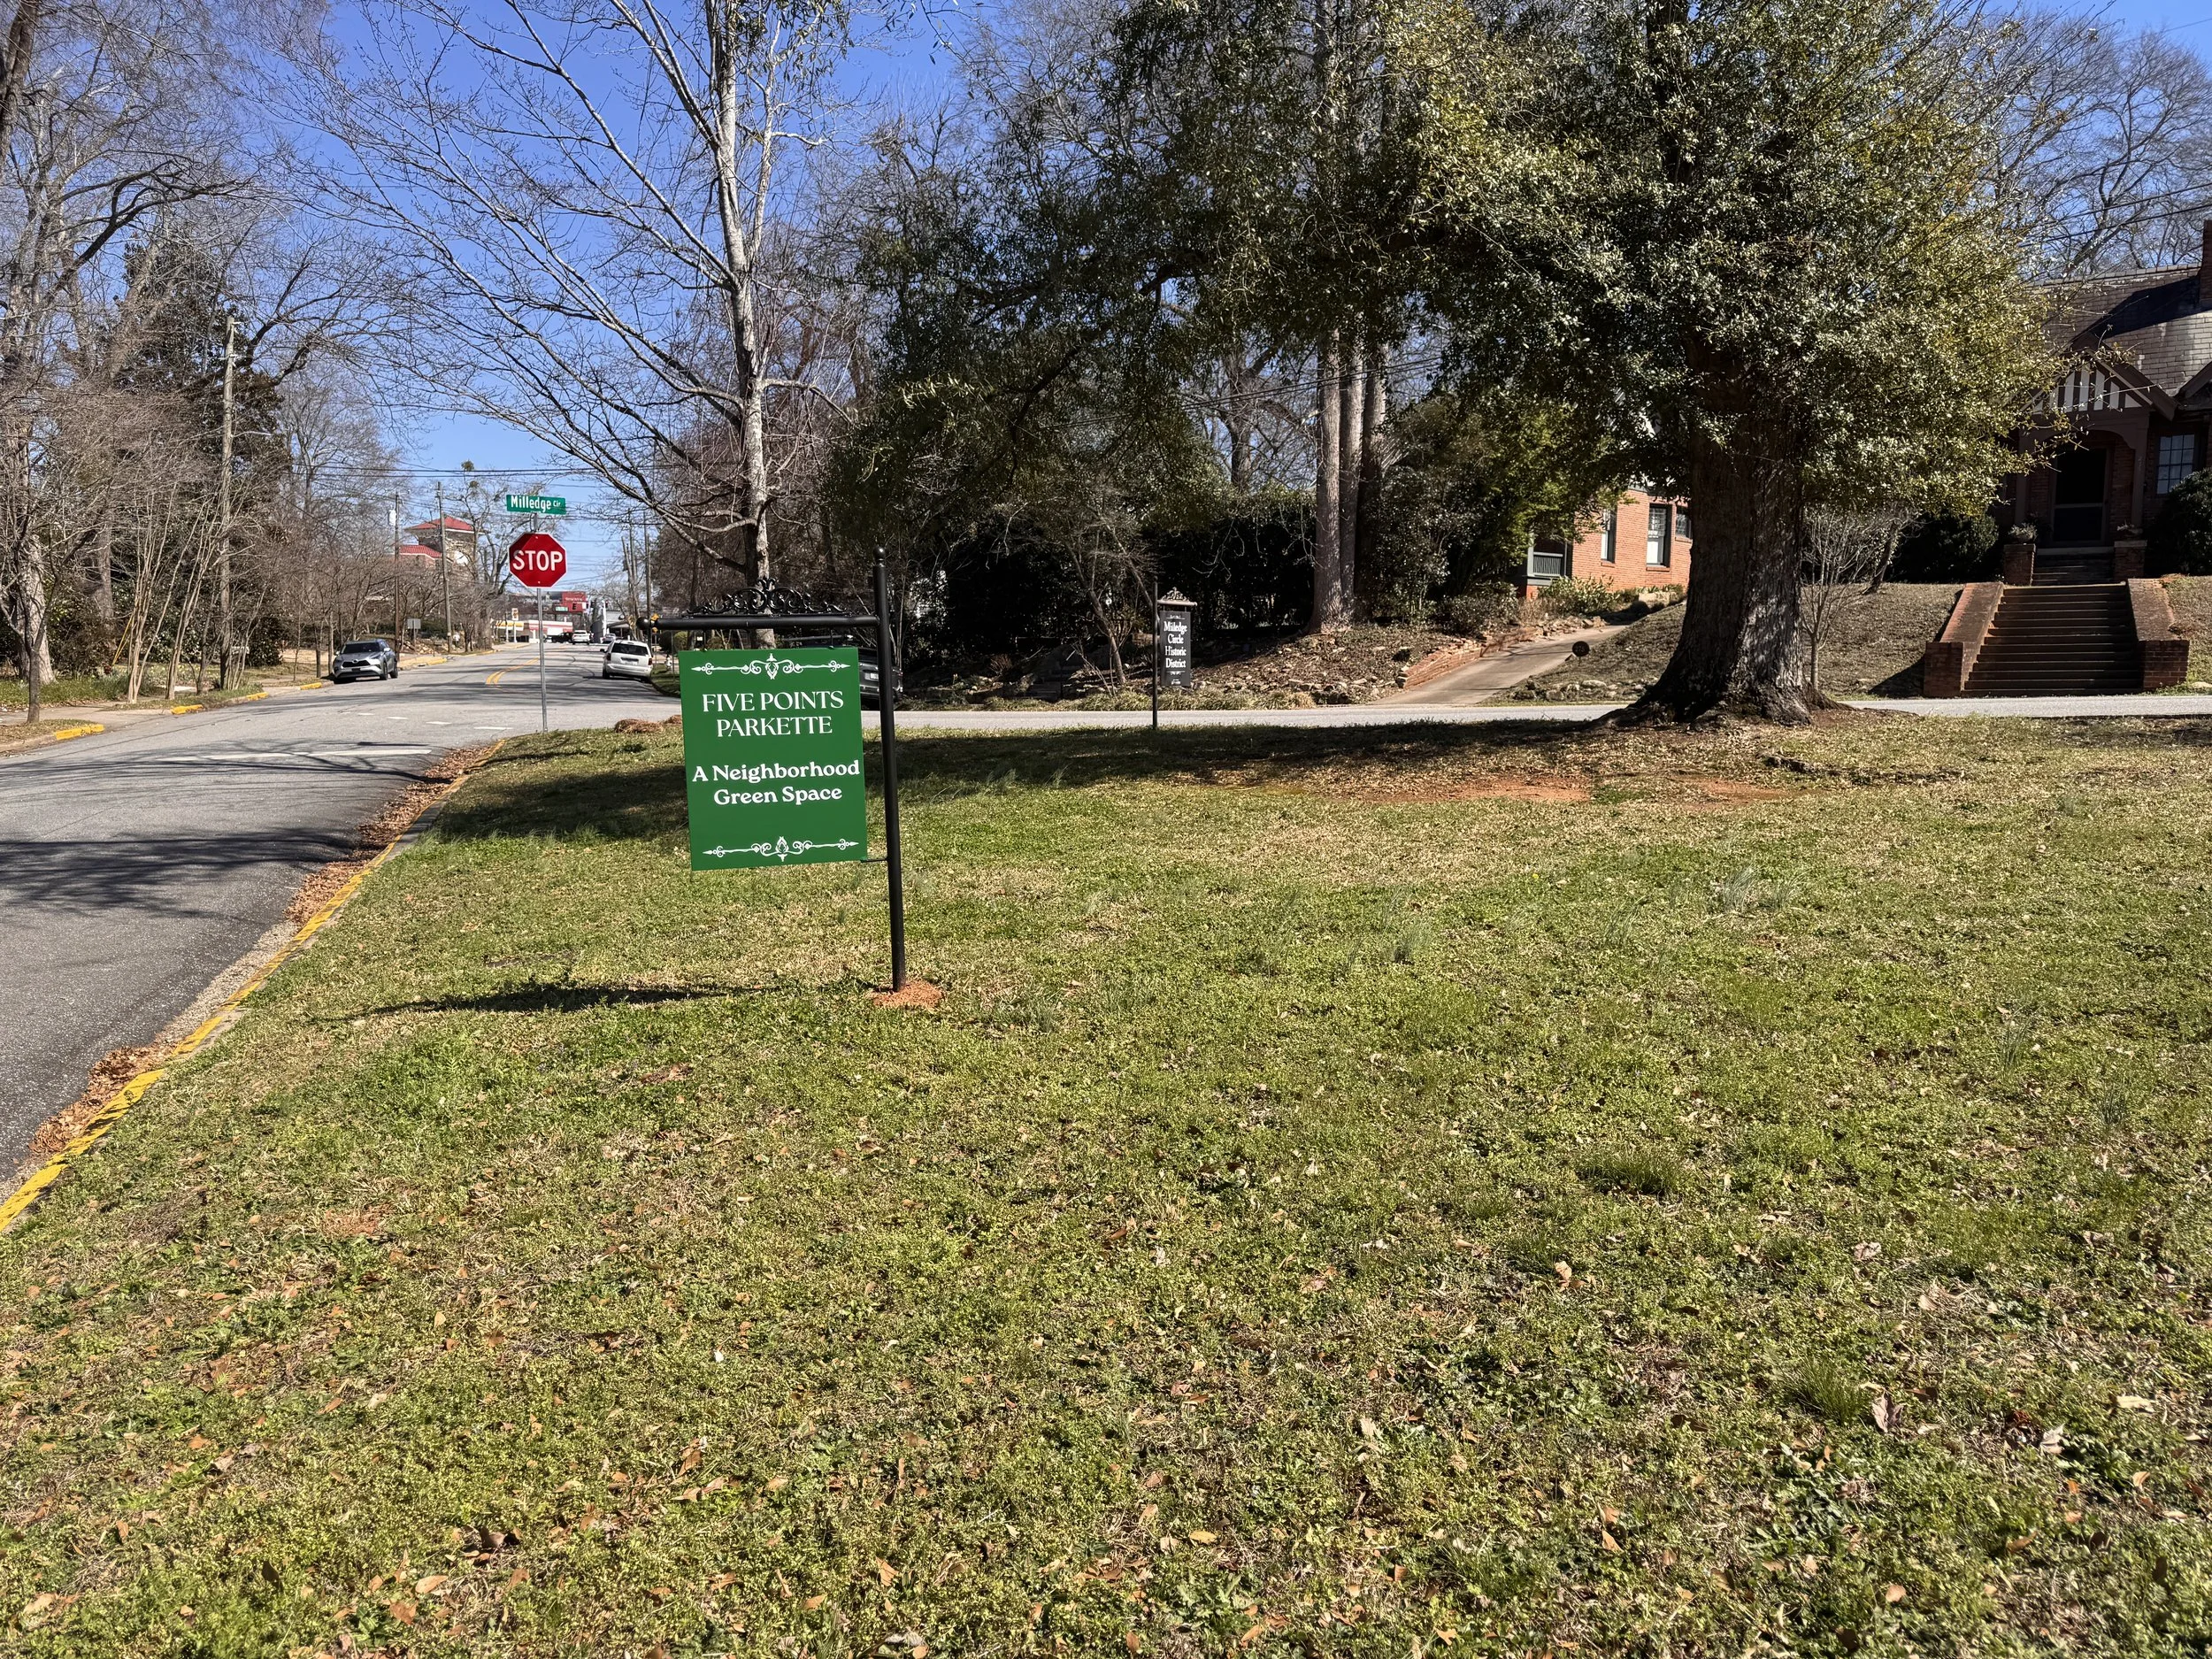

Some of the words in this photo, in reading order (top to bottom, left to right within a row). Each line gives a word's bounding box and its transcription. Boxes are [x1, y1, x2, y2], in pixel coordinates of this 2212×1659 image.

[511, 495, 551, 512] Milledge
[513, 550, 563, 571] STOP
[1165, 646, 1187, 657] Historic
[1166, 658, 1187, 668] District
[703, 693, 755, 712] FIVE
[760, 691, 844, 710] POINTS
[717, 716, 833, 737] PARKETTE
[692, 766, 709, 782] A
[713, 760, 860, 783] Neighborhood
[714, 788, 778, 805] Green
[782, 786, 842, 805] Space
